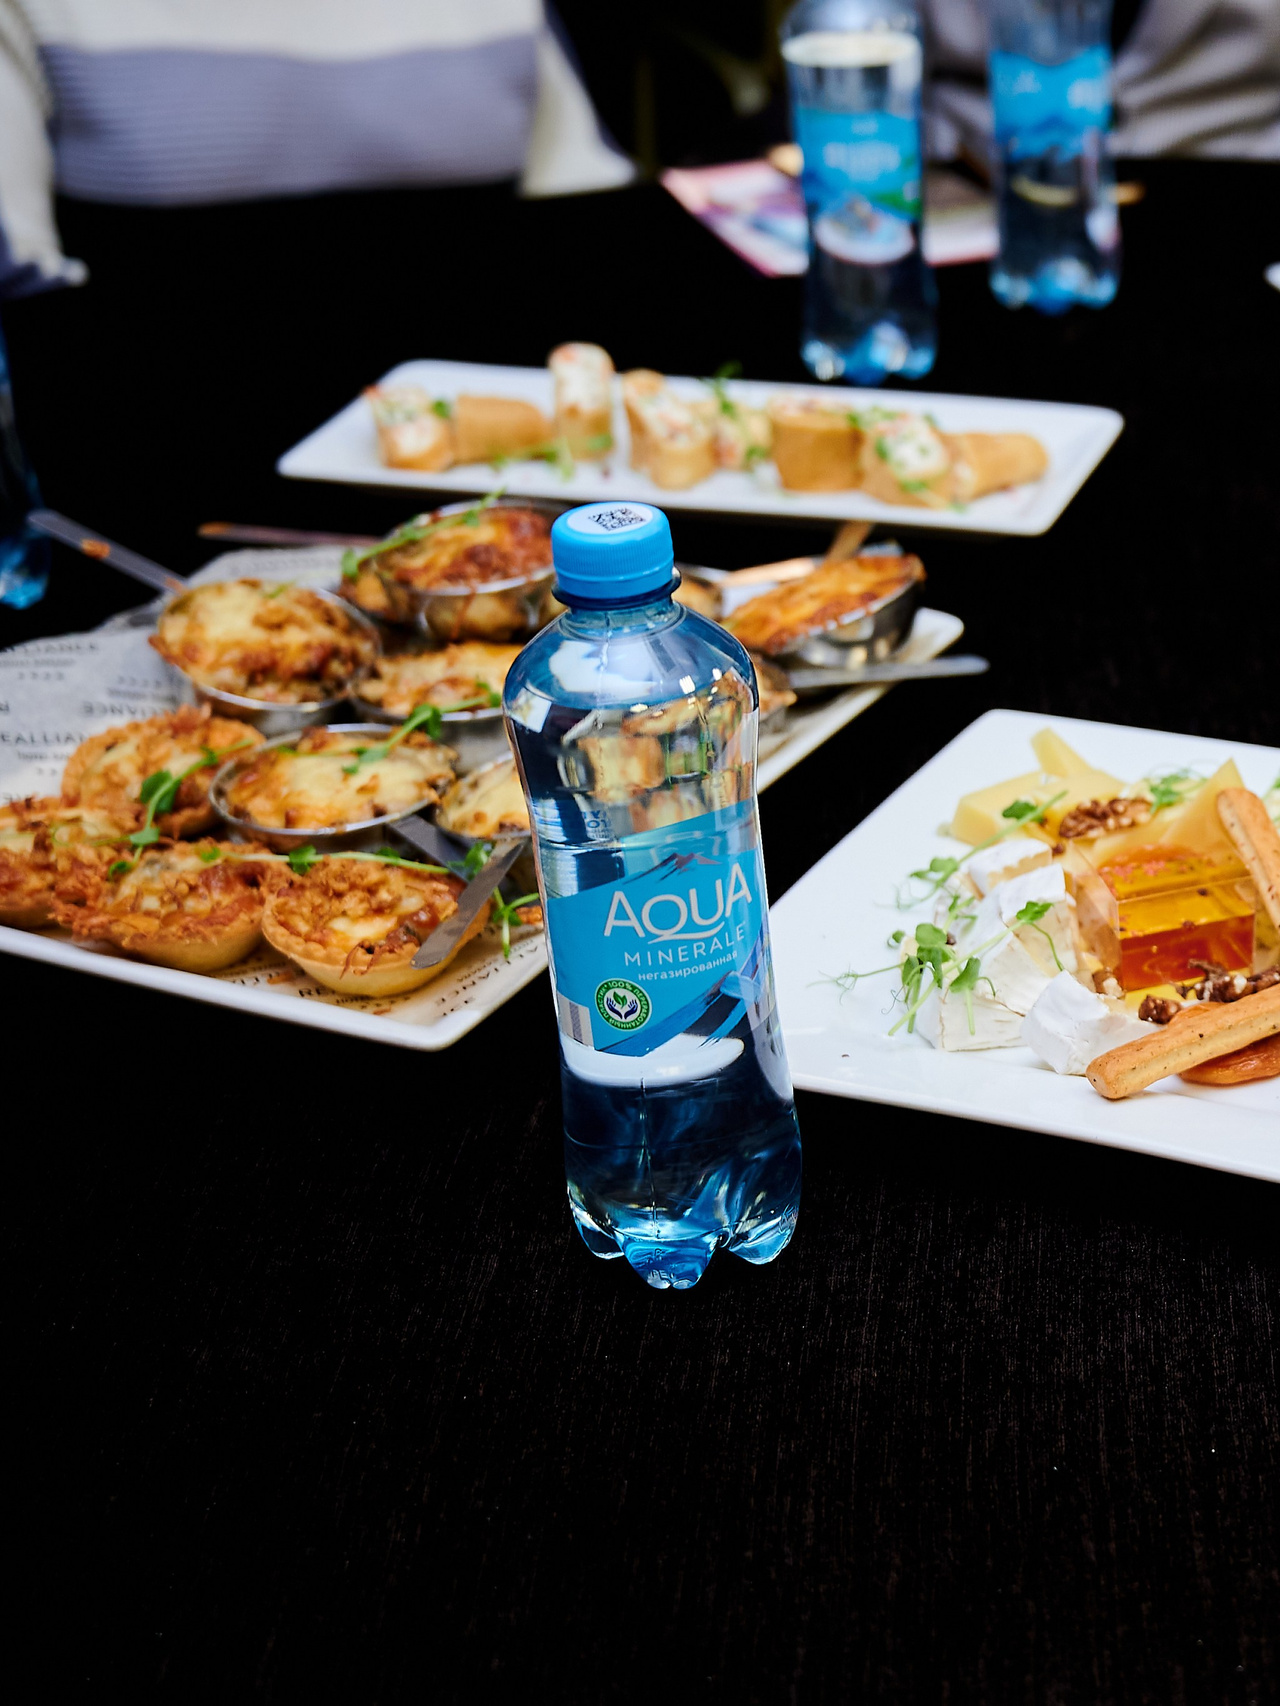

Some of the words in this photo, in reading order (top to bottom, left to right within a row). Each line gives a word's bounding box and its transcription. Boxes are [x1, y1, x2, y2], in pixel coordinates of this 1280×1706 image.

[603, 862, 753, 945] AQUA
[624, 925, 746, 967] MINERALE
[638, 950, 738, 981] негазированная
